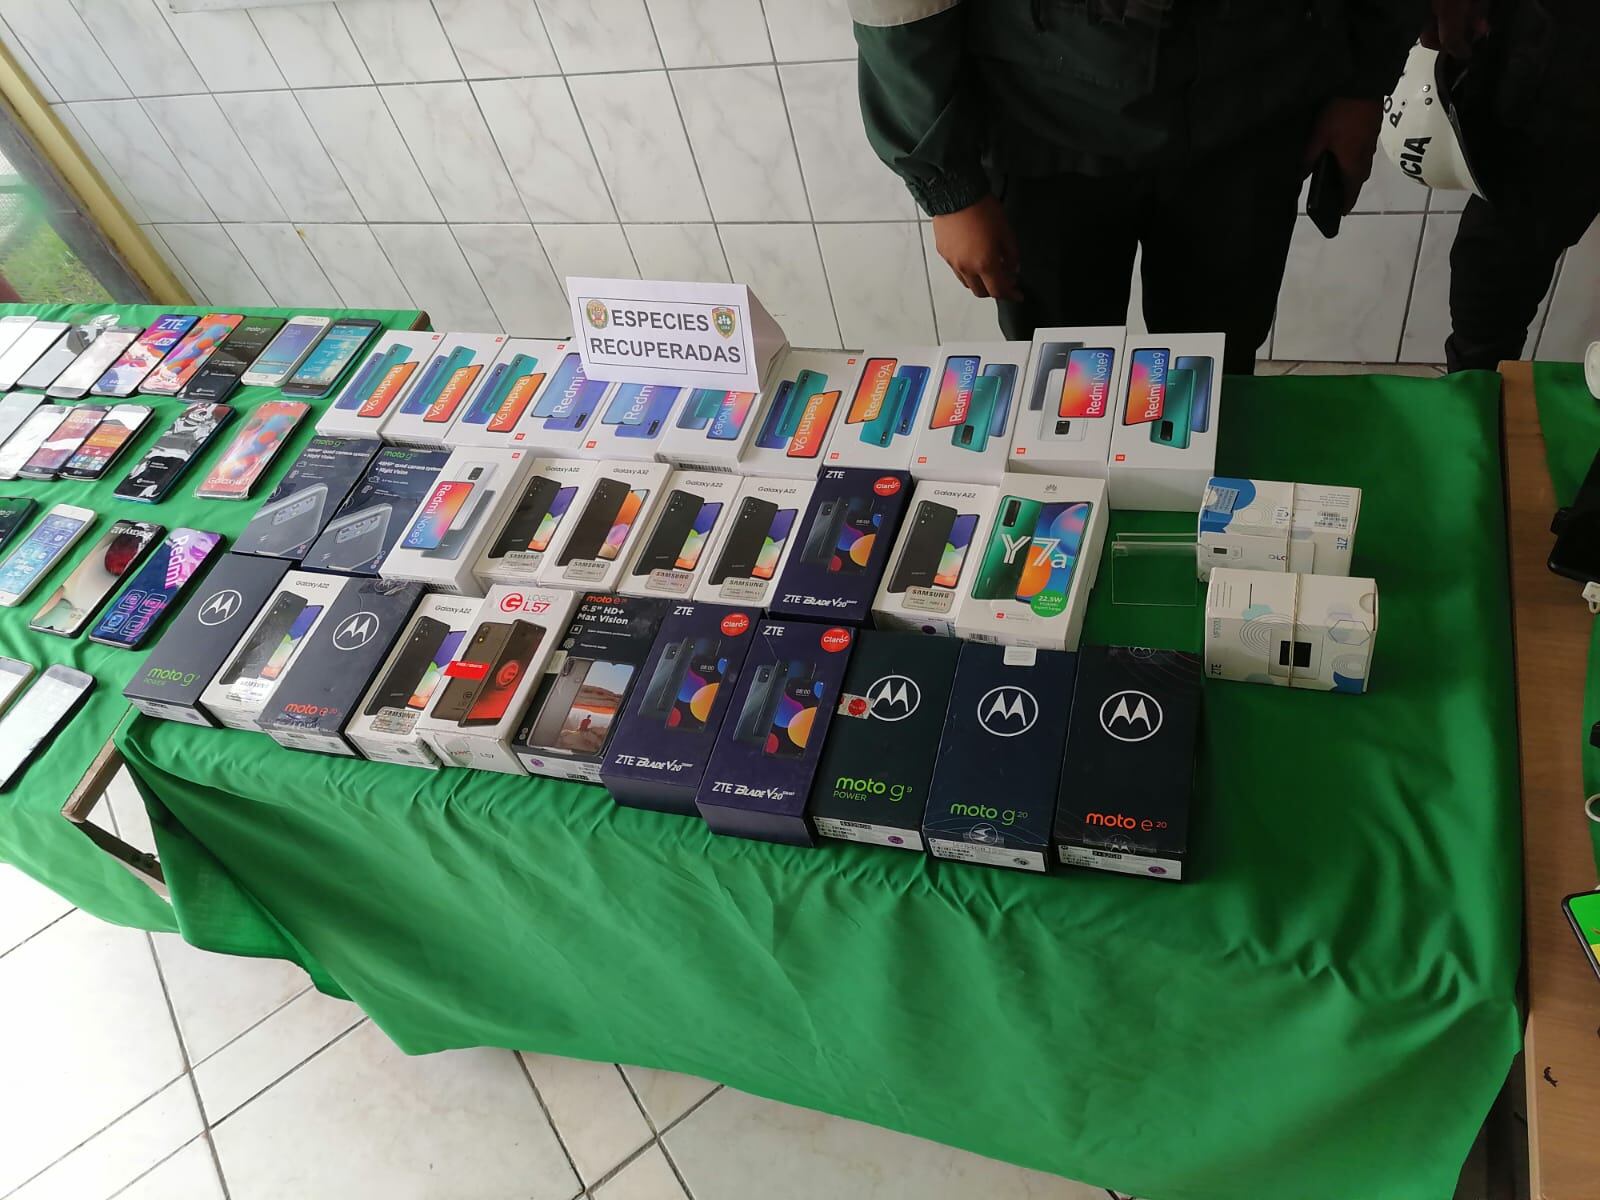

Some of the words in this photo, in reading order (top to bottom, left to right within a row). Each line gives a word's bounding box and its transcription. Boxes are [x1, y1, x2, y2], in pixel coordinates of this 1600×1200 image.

[157, 318, 187, 330] ZTE
[612, 309, 709, 332] ESPECIES
[590, 337, 741, 363] RECUPERADAS
[375, 364, 403, 399] Redmi
[441, 367, 469, 402] Redmi
[504, 377, 530, 411] Redmi
[552, 373, 583, 414] Redmi
[864, 376, 888, 419] Redmi
[878, 362, 893, 379] 9A
[623, 385, 655, 422] Redm
[1086, 381, 1104, 415] Redmi
[1144, 383, 1162, 419] Redmi
[950, 388, 970, 424] Redmi
[797, 397, 824, 436] Redmi
[791, 436, 806, 452] 9A
[613, 467, 635, 475] Galaxy
[825, 471, 845, 479] ZTE
[685, 480, 709, 488] Galaxy
[758, 486, 782, 494] Galaxy
[426, 484, 452, 514] Redmi
[933, 489, 961, 499] Galaxy
[164, 535, 190, 590] Redmi
[574, 561, 605, 569] SAMSUNG
[655, 571, 690, 580] SAMSUNG
[295, 580, 317, 589] Galaxy
[729, 580, 764, 588] SAMSUNG
[586, 595, 612, 604] moto
[783, 595, 802, 603] ZTE
[912, 590, 950, 599] SAMSUNG
[435, 605, 459, 614] Galaxy
[523, 601, 551, 613] L57
[603, 607, 624, 615] HD+
[673, 606, 694, 616] ZTE
[577, 613, 597, 621] Max
[600, 615, 628, 624] Vision
[723, 620, 743, 628] Claro
[763, 626, 785, 636] ZTE
[823, 635, 844, 643] Claro
[147, 667, 182, 680] moto
[285, 703, 318, 715] moto
[384, 710, 416, 719] SAMSUNG
[615, 754, 635, 766] ZTE
[712, 781, 733, 793] ZTE
[835, 776, 886, 795] moto
[833, 790, 867, 801] POWER
[950, 803, 998, 819] moto
[1086, 812, 1136, 830] moto
